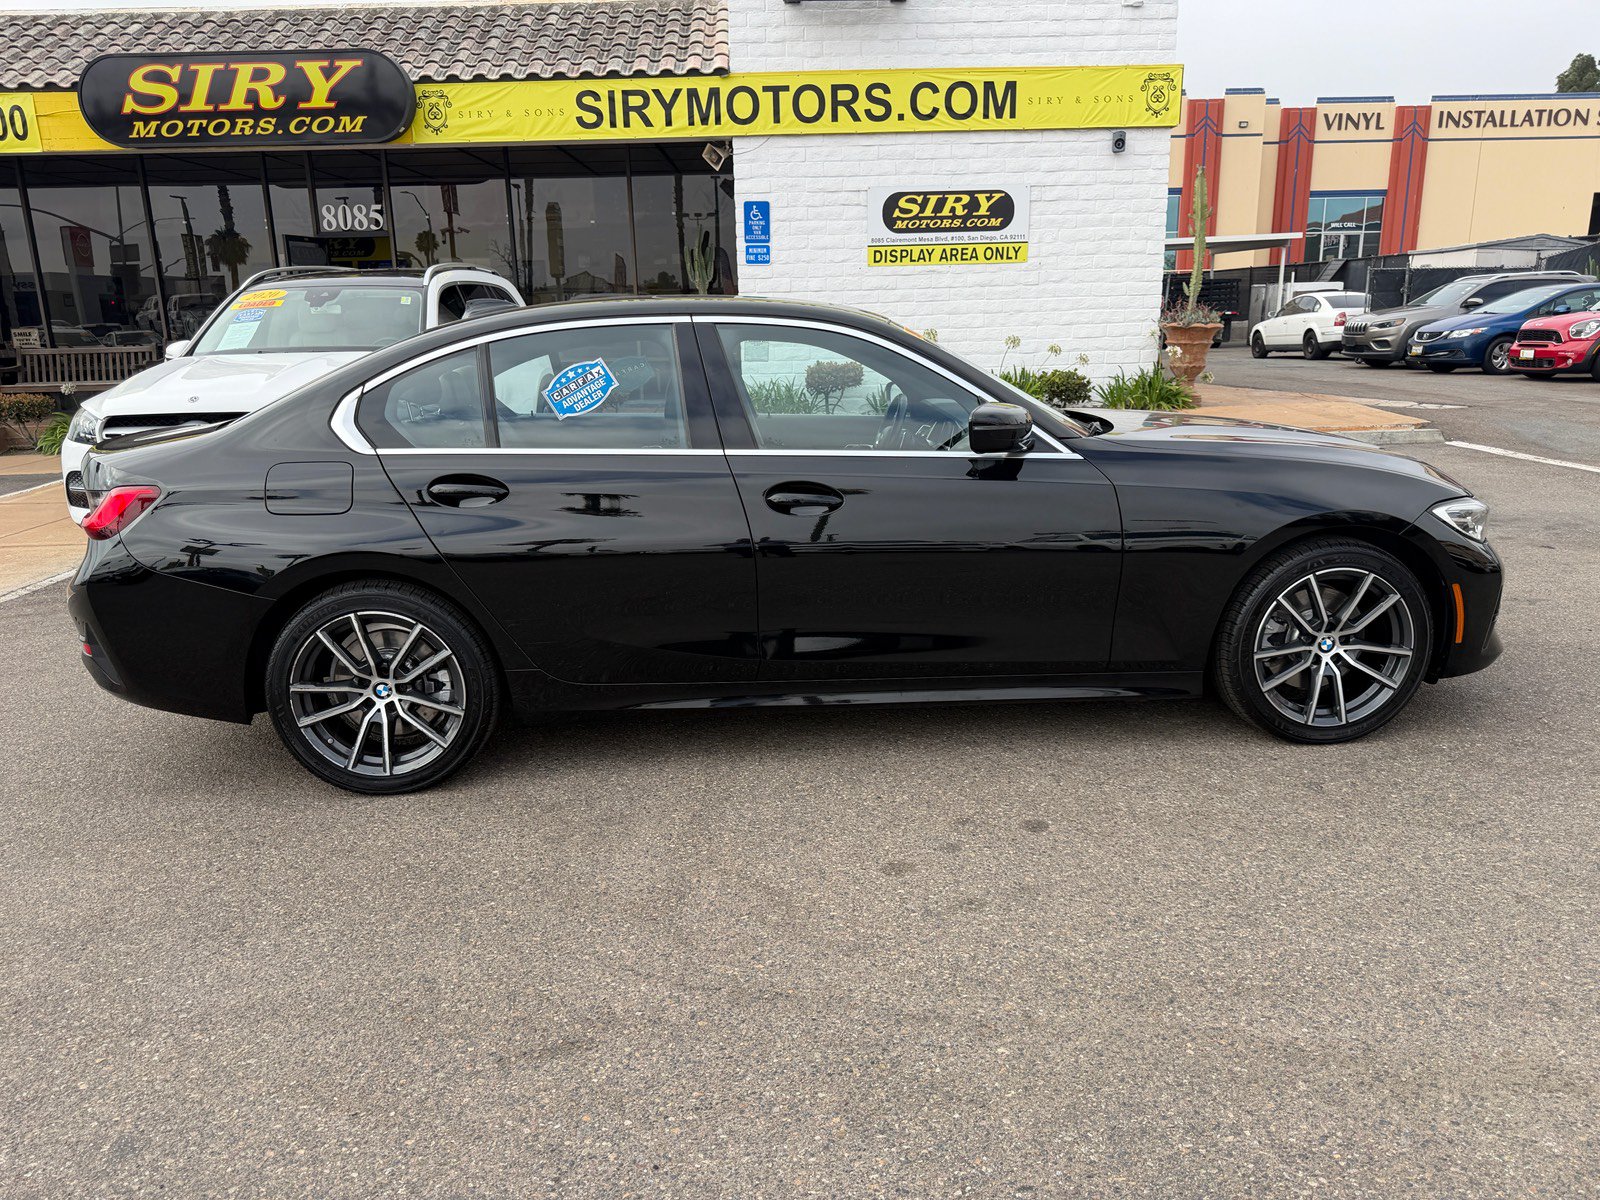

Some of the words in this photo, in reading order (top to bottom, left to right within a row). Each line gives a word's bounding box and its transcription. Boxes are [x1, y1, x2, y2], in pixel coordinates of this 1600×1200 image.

[121, 58, 364, 115] SIRY
[575, 80, 1017, 129] SIRYMOTORS.COM
[1028, 96, 1064, 105] SIRY
[1075, 95, 1082, 104] &
[1094, 94, 1134, 103] SONS
[458, 110, 495, 119] SIRY
[505, 109, 513, 118] &
[524, 108, 565, 117] SONS
[1323, 112, 1385, 131] VINYL
[1437, 108, 1590, 129] INSTALLATION
[129, 115, 368, 139] MOTORS.COM
[892, 193, 1005, 218] SIRY
[321, 204, 384, 231] 8085
[893, 217, 1004, 229] MOTORS.COM
[873, 248, 935, 264] DISPLAY
[939, 247, 979, 262] AREA
[983, 245, 1022, 261] ONLY
[552, 369, 604, 401] CARFAX
[562, 378, 607, 409] ADVANTAGE
[573, 390, 605, 412] DEALER
